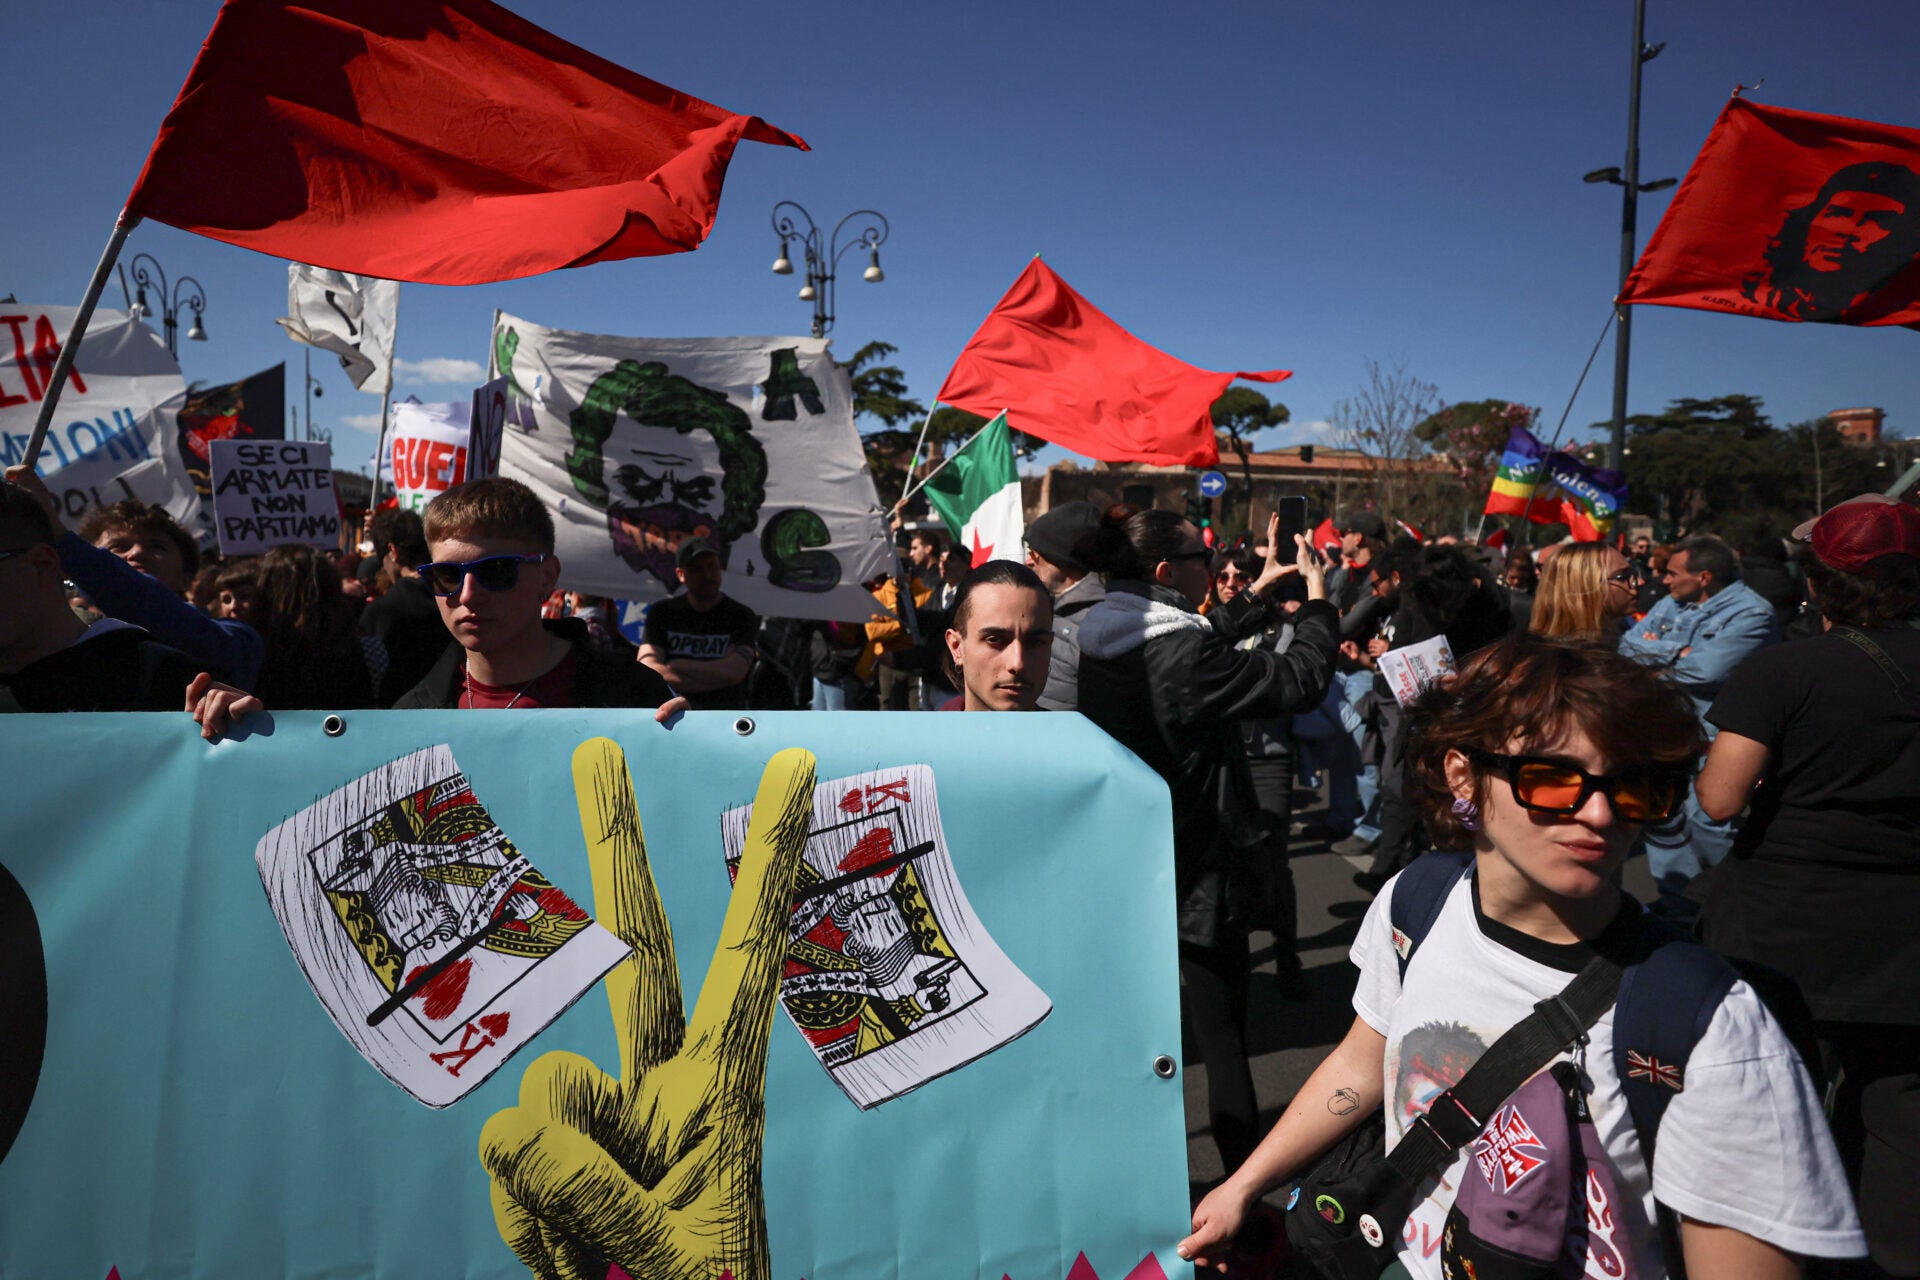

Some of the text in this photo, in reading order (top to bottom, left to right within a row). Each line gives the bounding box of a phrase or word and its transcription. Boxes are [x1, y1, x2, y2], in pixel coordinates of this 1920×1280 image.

[236, 444, 309, 467] SE CI
[216, 467, 331, 496] ARMATE
[250, 493, 307, 515] NON
[223, 513, 338, 542] PARTIAMO
